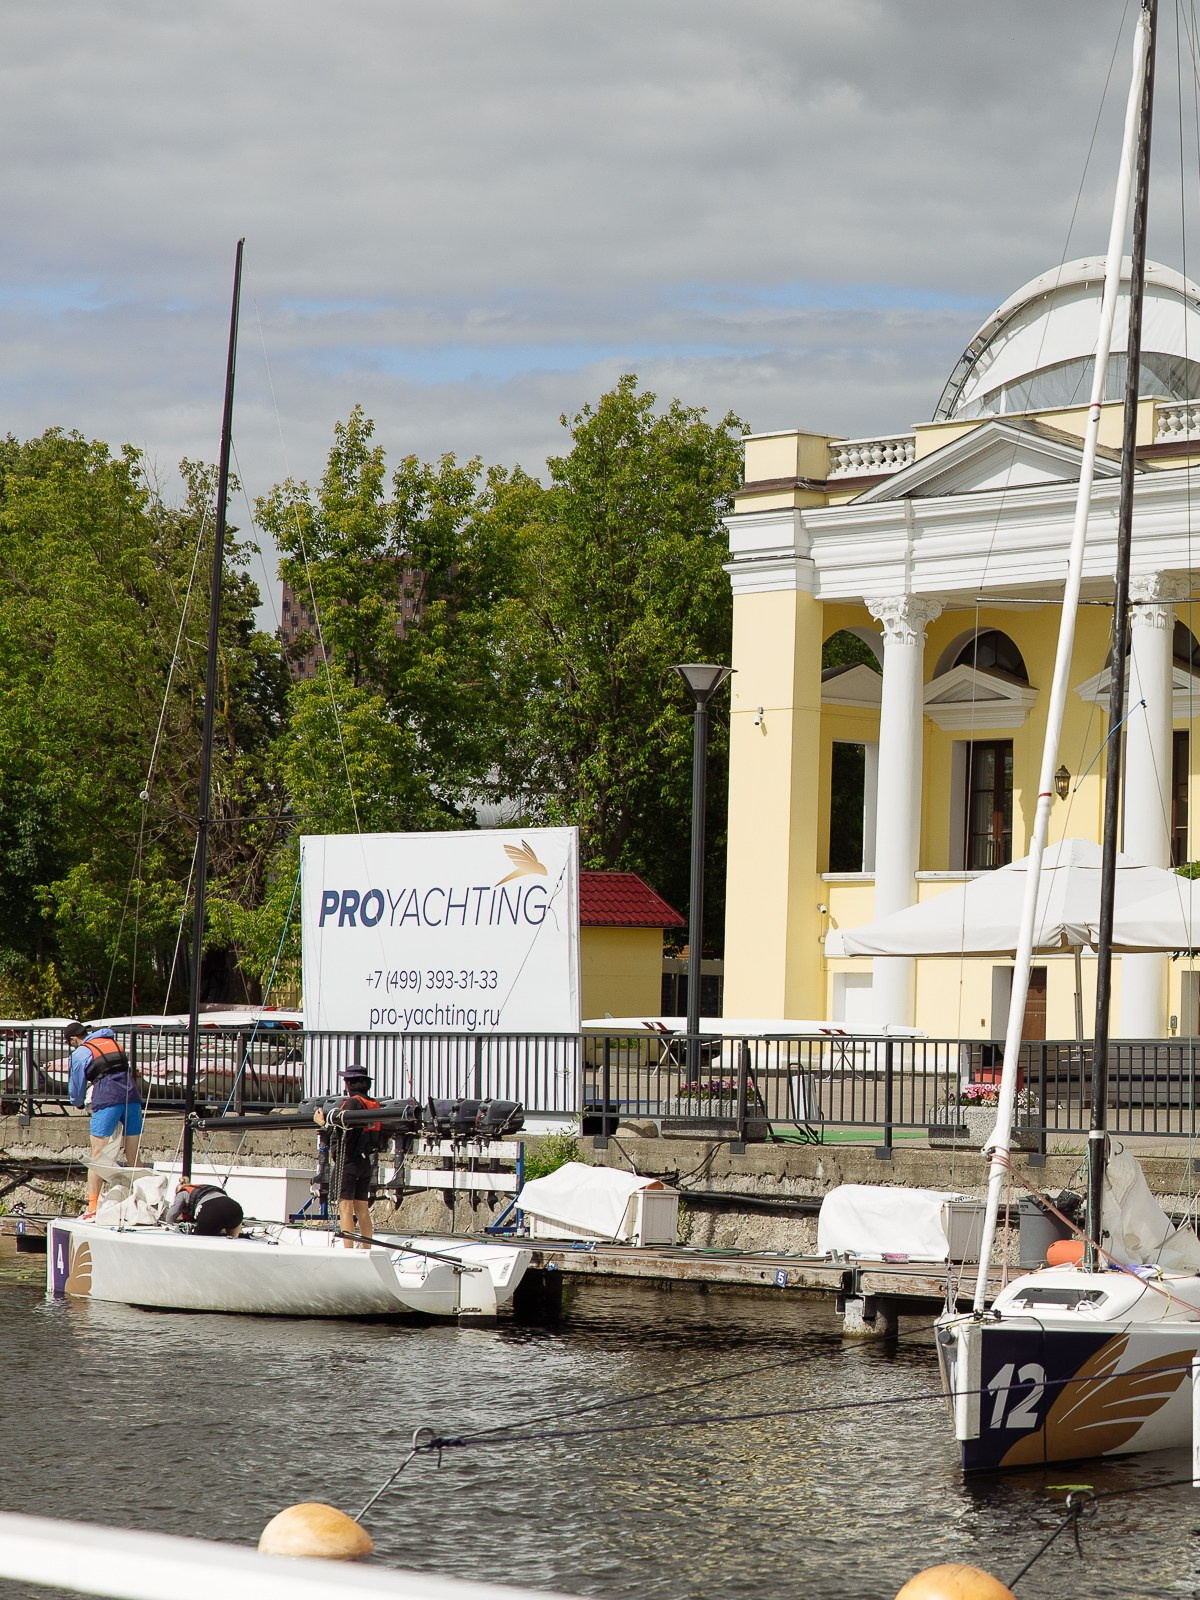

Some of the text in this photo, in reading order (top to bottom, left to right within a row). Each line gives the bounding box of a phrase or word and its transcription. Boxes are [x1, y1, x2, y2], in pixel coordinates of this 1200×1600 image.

[318, 884, 548, 928] PROYACHTING
[365, 970, 498, 993] +7 (499) 393-31-33
[370, 1003, 500, 1031] pro-yachting.ru
[56, 1243, 65, 1275] 4
[777, 1271, 785, 1284] 5
[987, 1363, 1046, 1429] 12
